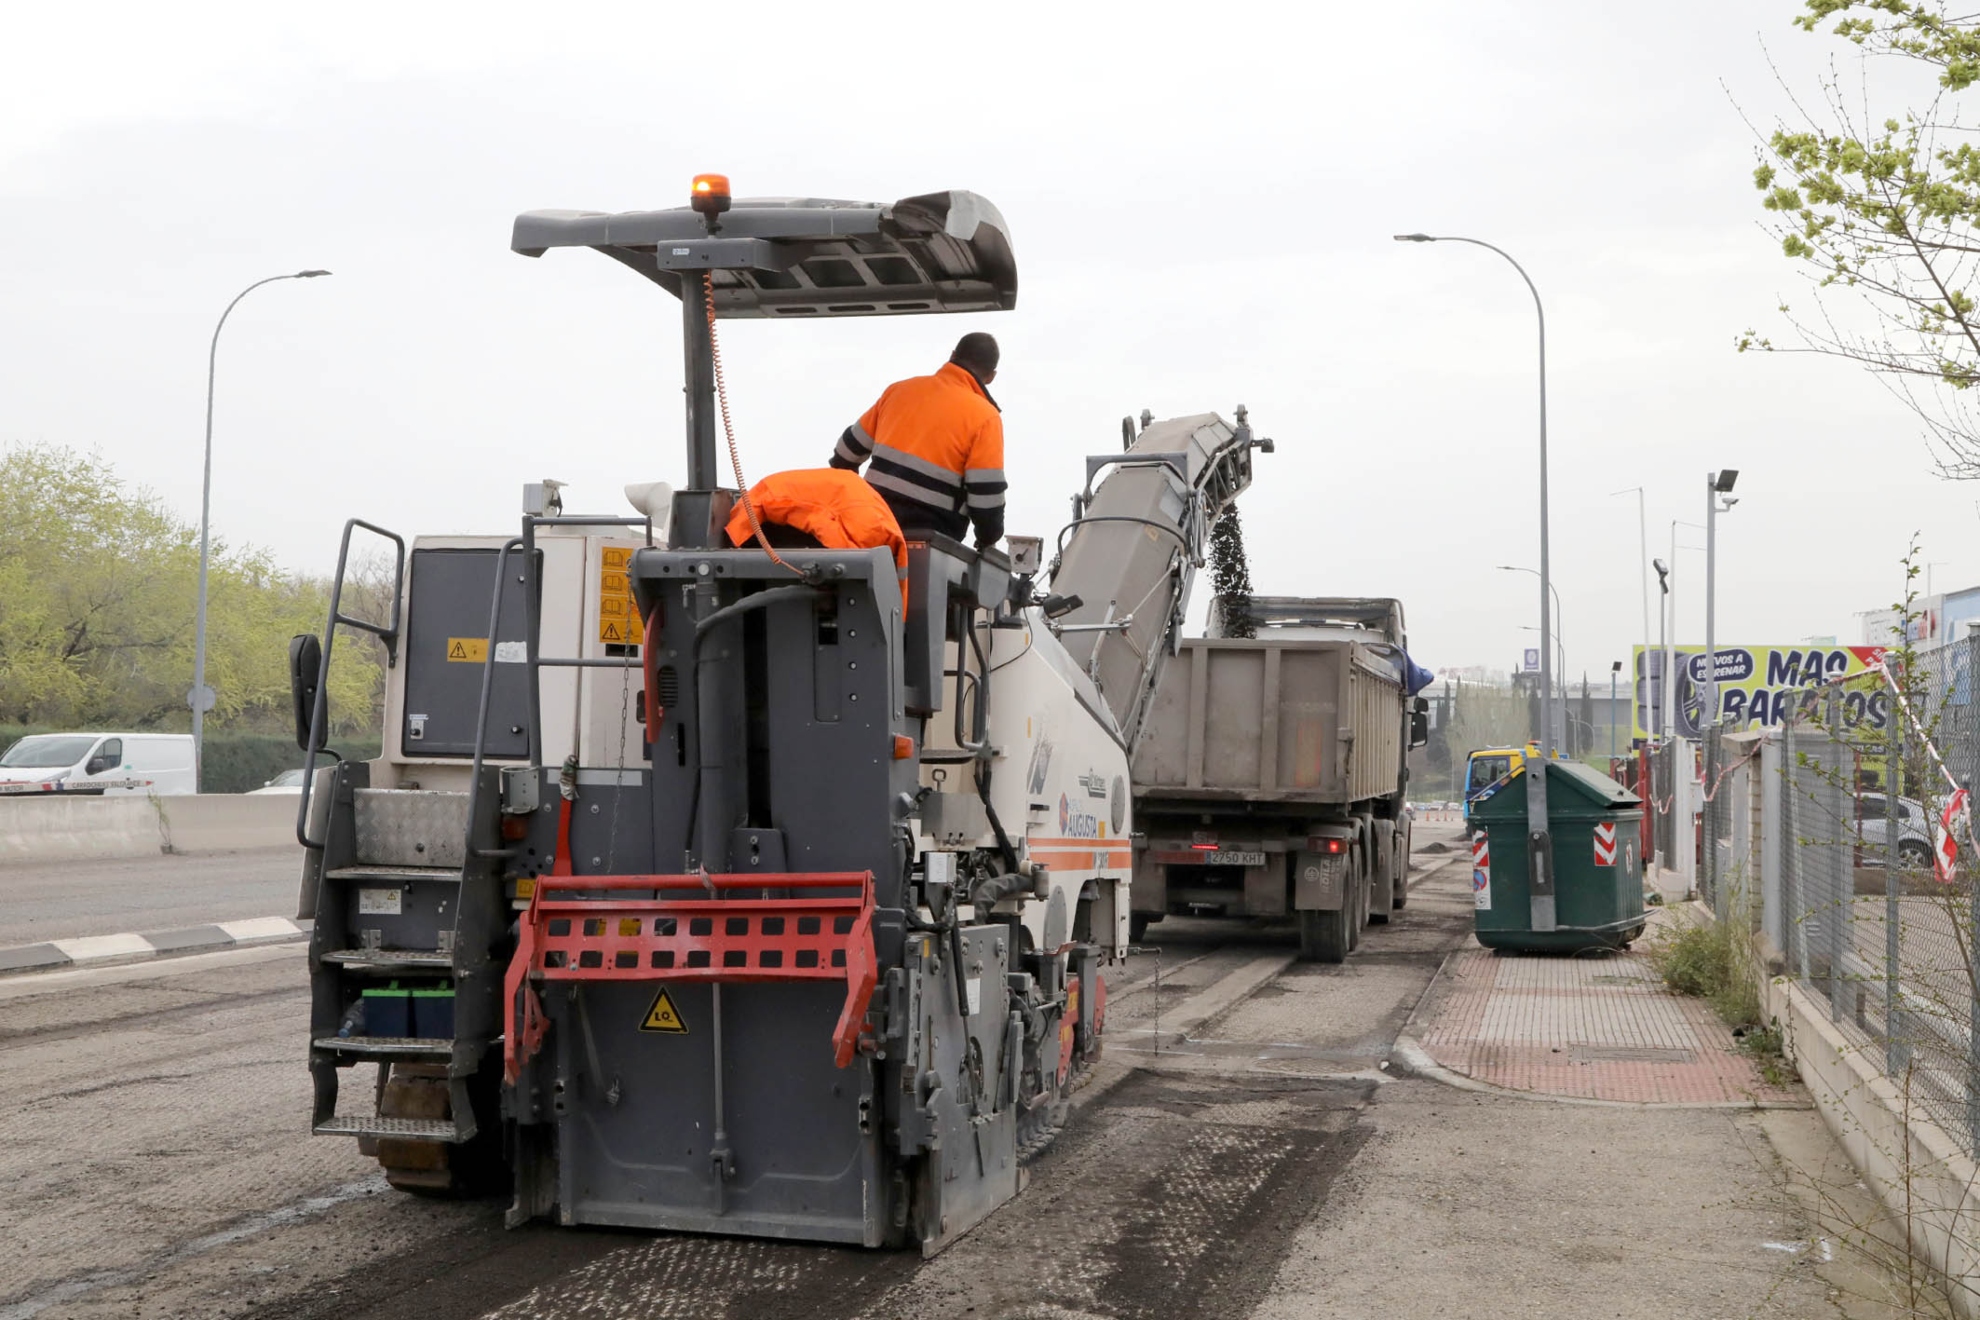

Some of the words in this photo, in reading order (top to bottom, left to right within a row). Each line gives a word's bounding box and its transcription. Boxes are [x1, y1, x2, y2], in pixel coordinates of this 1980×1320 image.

[1735, 653, 1744, 664] A
[1696, 664, 1746, 679] ESRENAR
[1768, 650, 1847, 687] MAS
[1068, 814, 1097, 838] AUGUSTA
[1212, 852, 1239, 863] 2750
[1242, 853, 1263, 864] KHT
